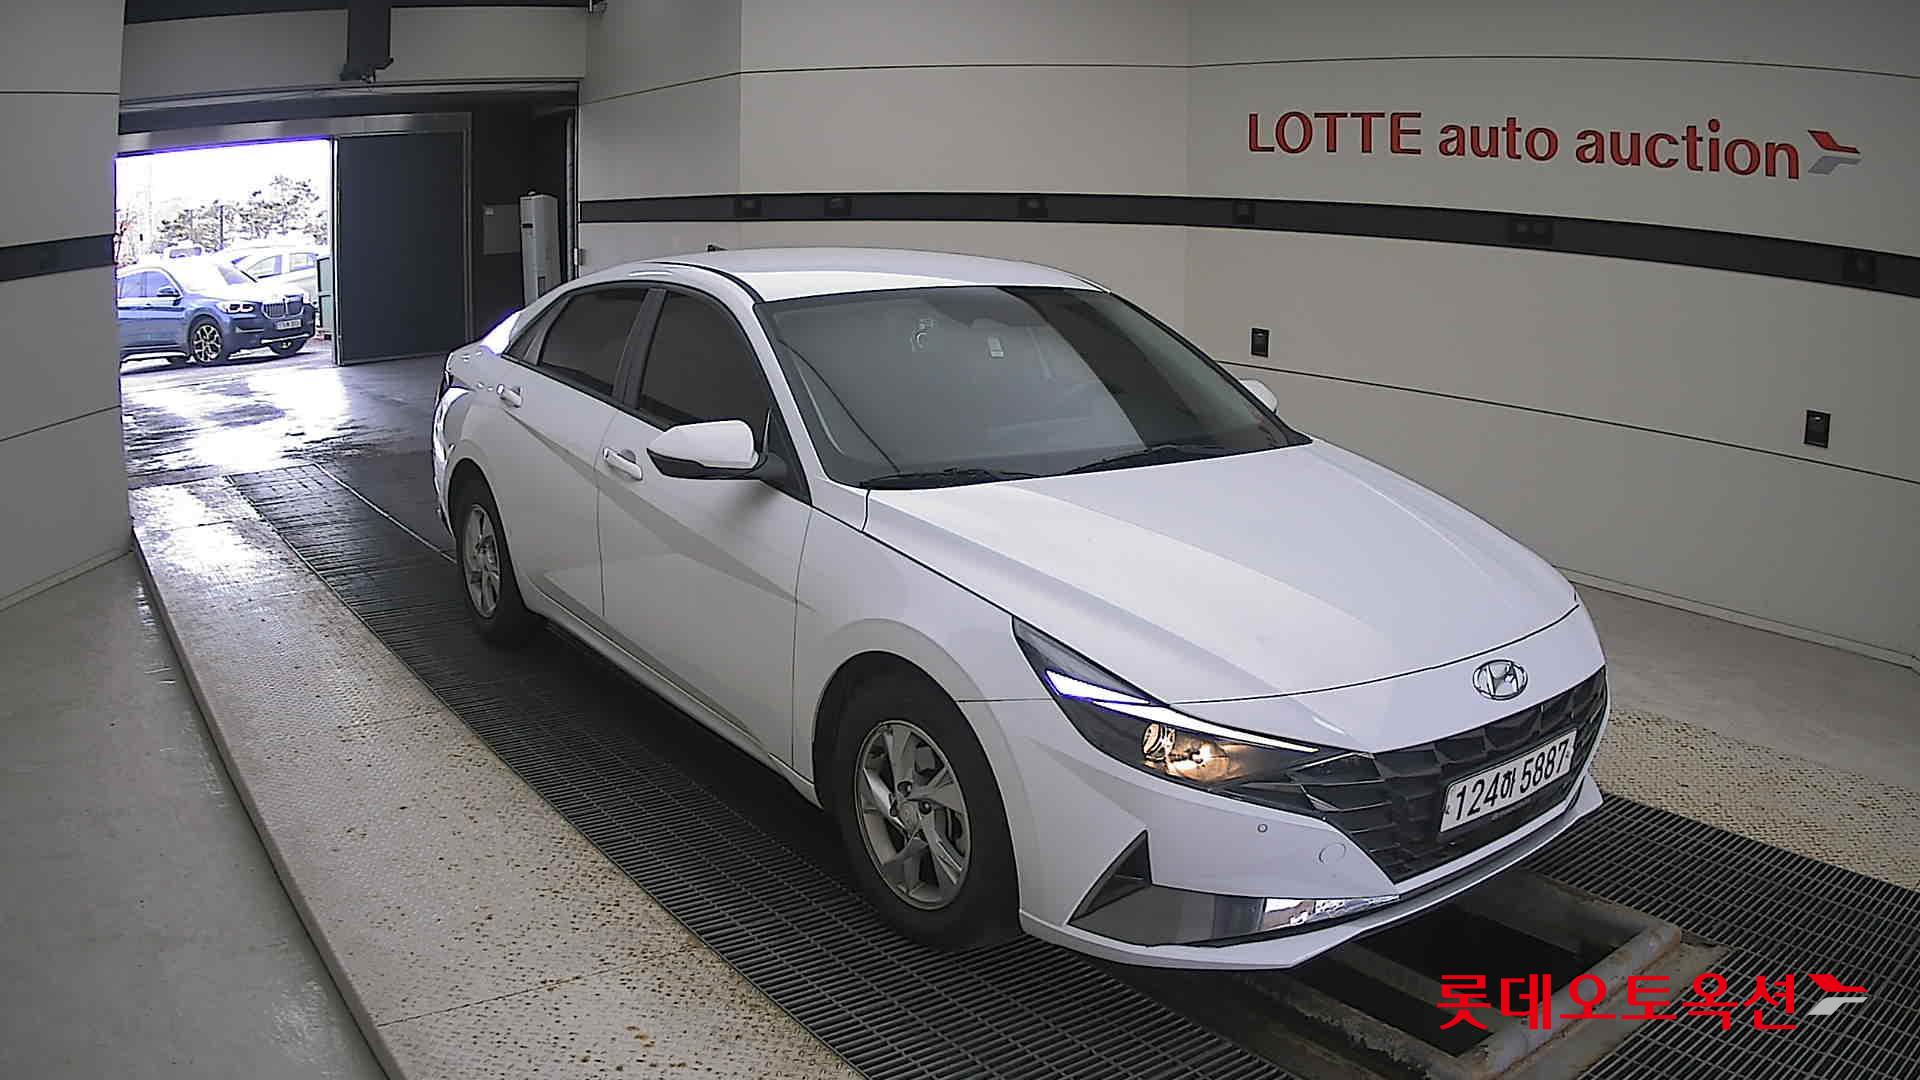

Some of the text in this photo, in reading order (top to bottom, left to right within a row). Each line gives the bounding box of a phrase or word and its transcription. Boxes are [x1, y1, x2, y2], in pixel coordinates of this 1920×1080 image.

[1248, 112, 1800, 180] LOTTE auto auction
[1456, 740, 1569, 821] 124하 5887
